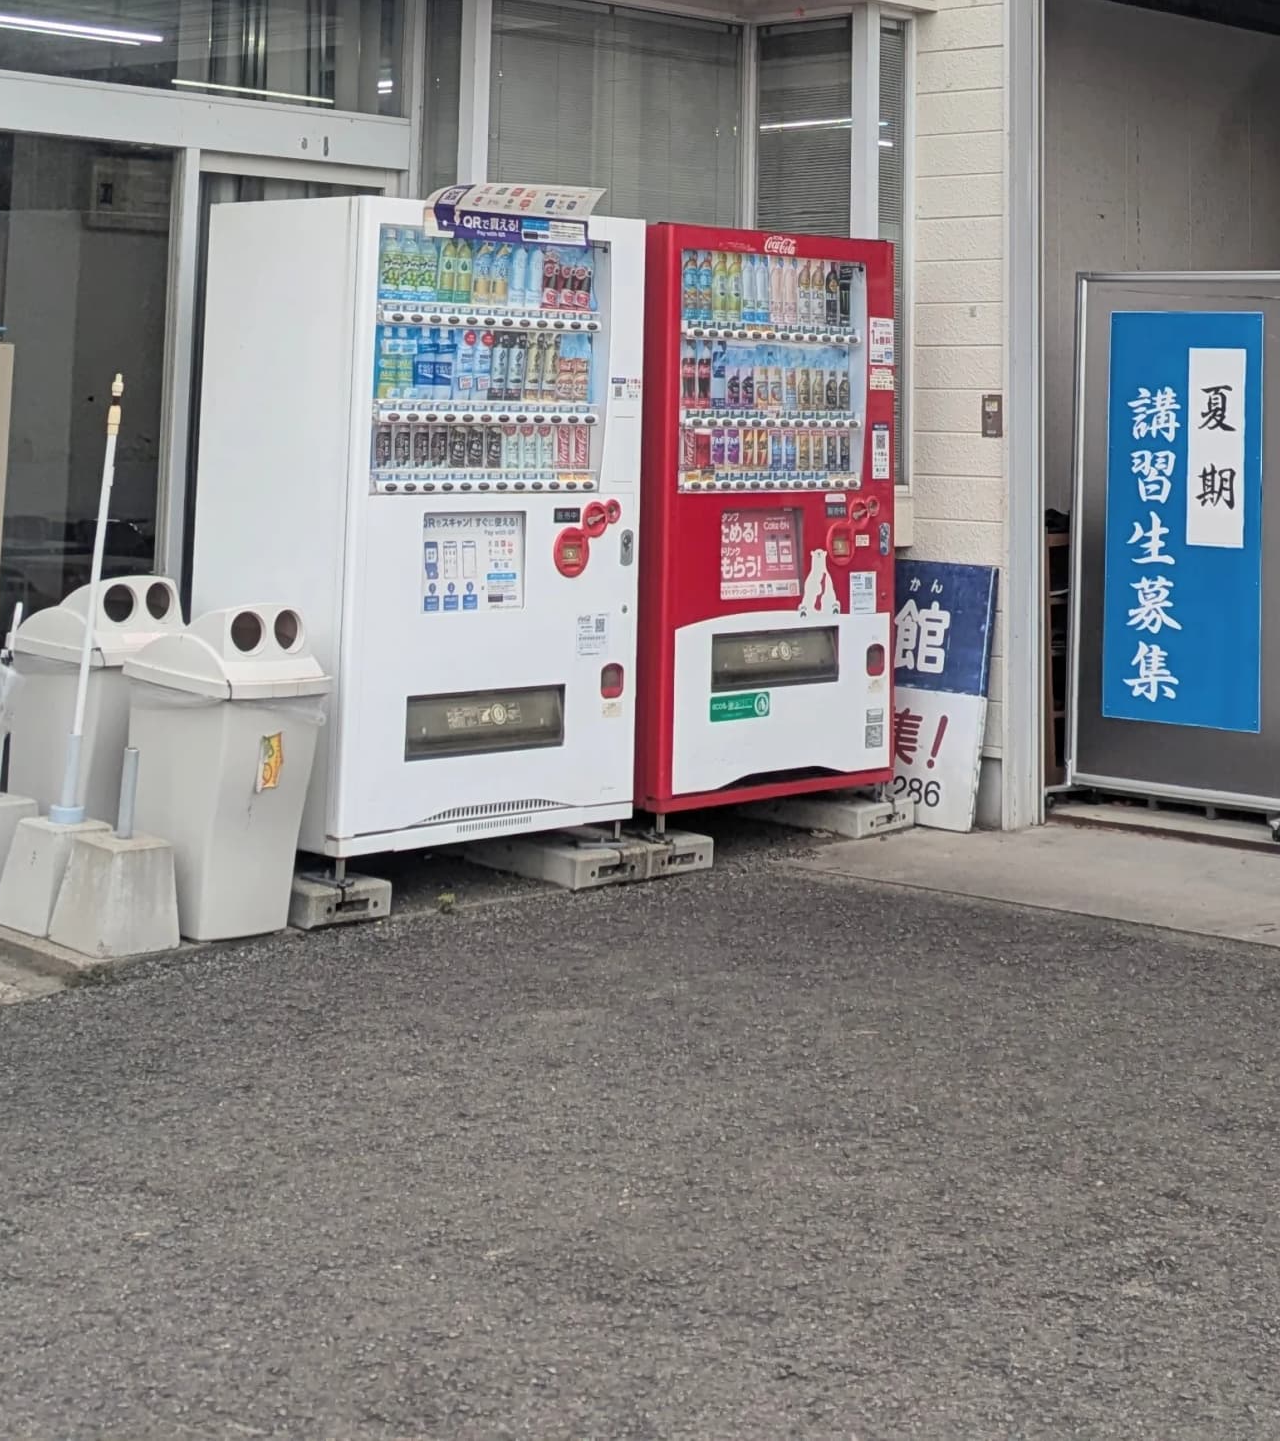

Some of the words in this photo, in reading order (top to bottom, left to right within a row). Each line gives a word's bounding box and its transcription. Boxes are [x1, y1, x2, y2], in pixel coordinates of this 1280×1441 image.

[1195, 384, 1237, 510] 夏期
[909, 577, 944, 595] かん
[1122, 386, 1182, 703] 講習生募集
[894, 598, 951, 674] 館
